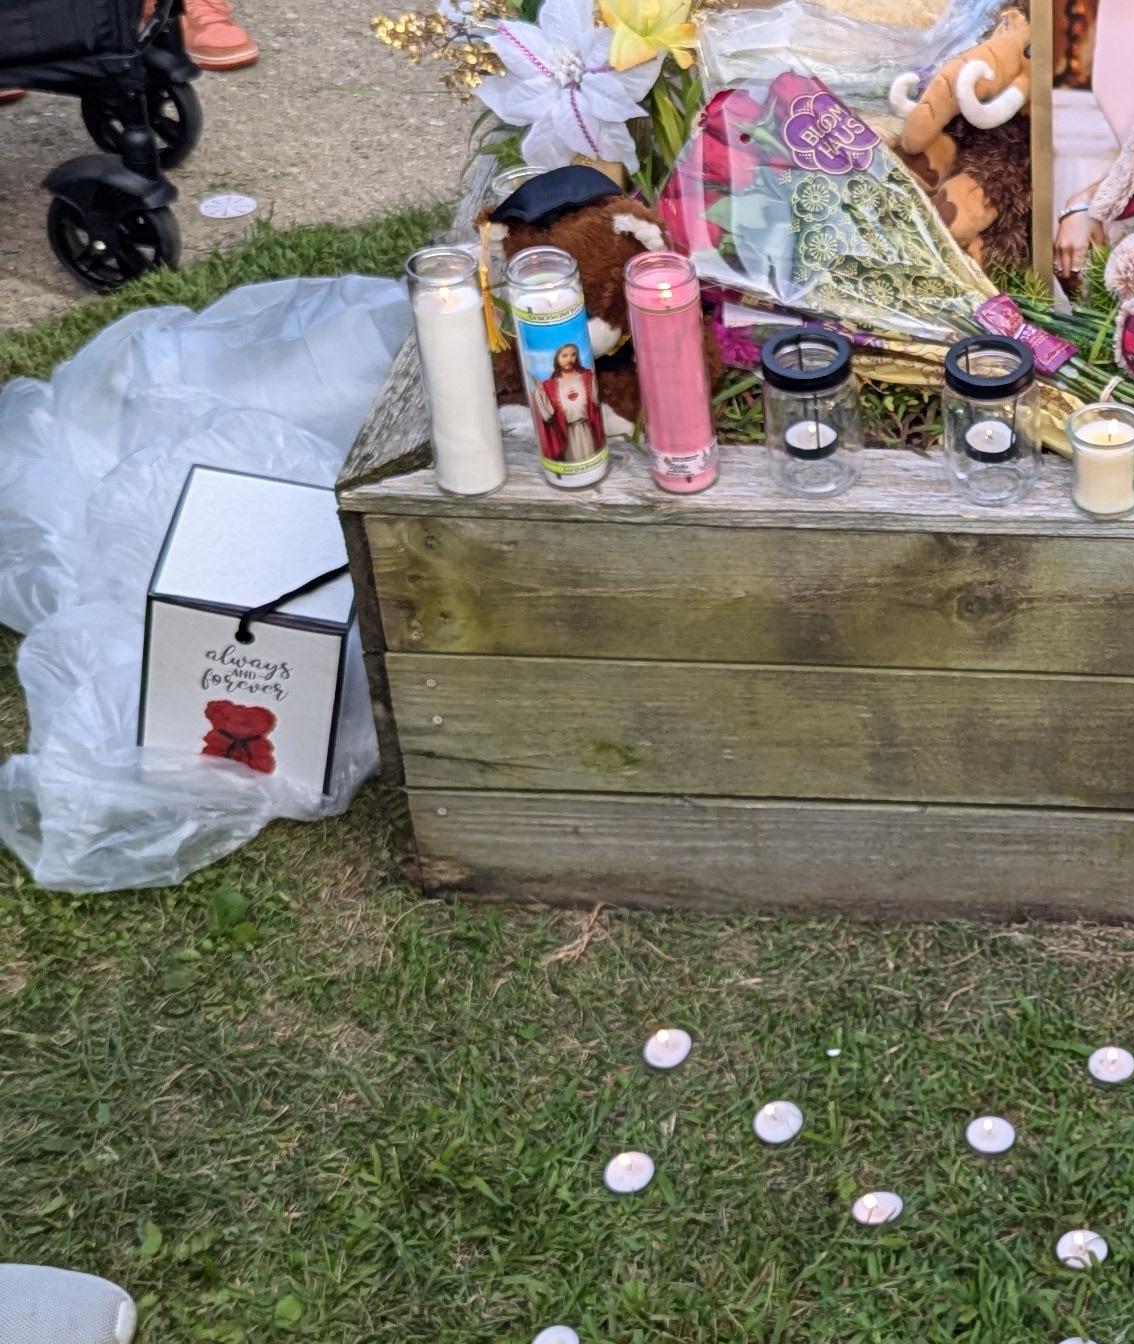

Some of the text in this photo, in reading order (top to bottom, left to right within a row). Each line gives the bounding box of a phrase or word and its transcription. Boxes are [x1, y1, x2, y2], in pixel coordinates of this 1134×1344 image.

[801, 103, 849, 146] BLOOM
[818, 118, 865, 160] HAUS
[205, 645, 293, 680] always
[231, 668, 256, 680] AND
[201, 668, 289, 701] forever
